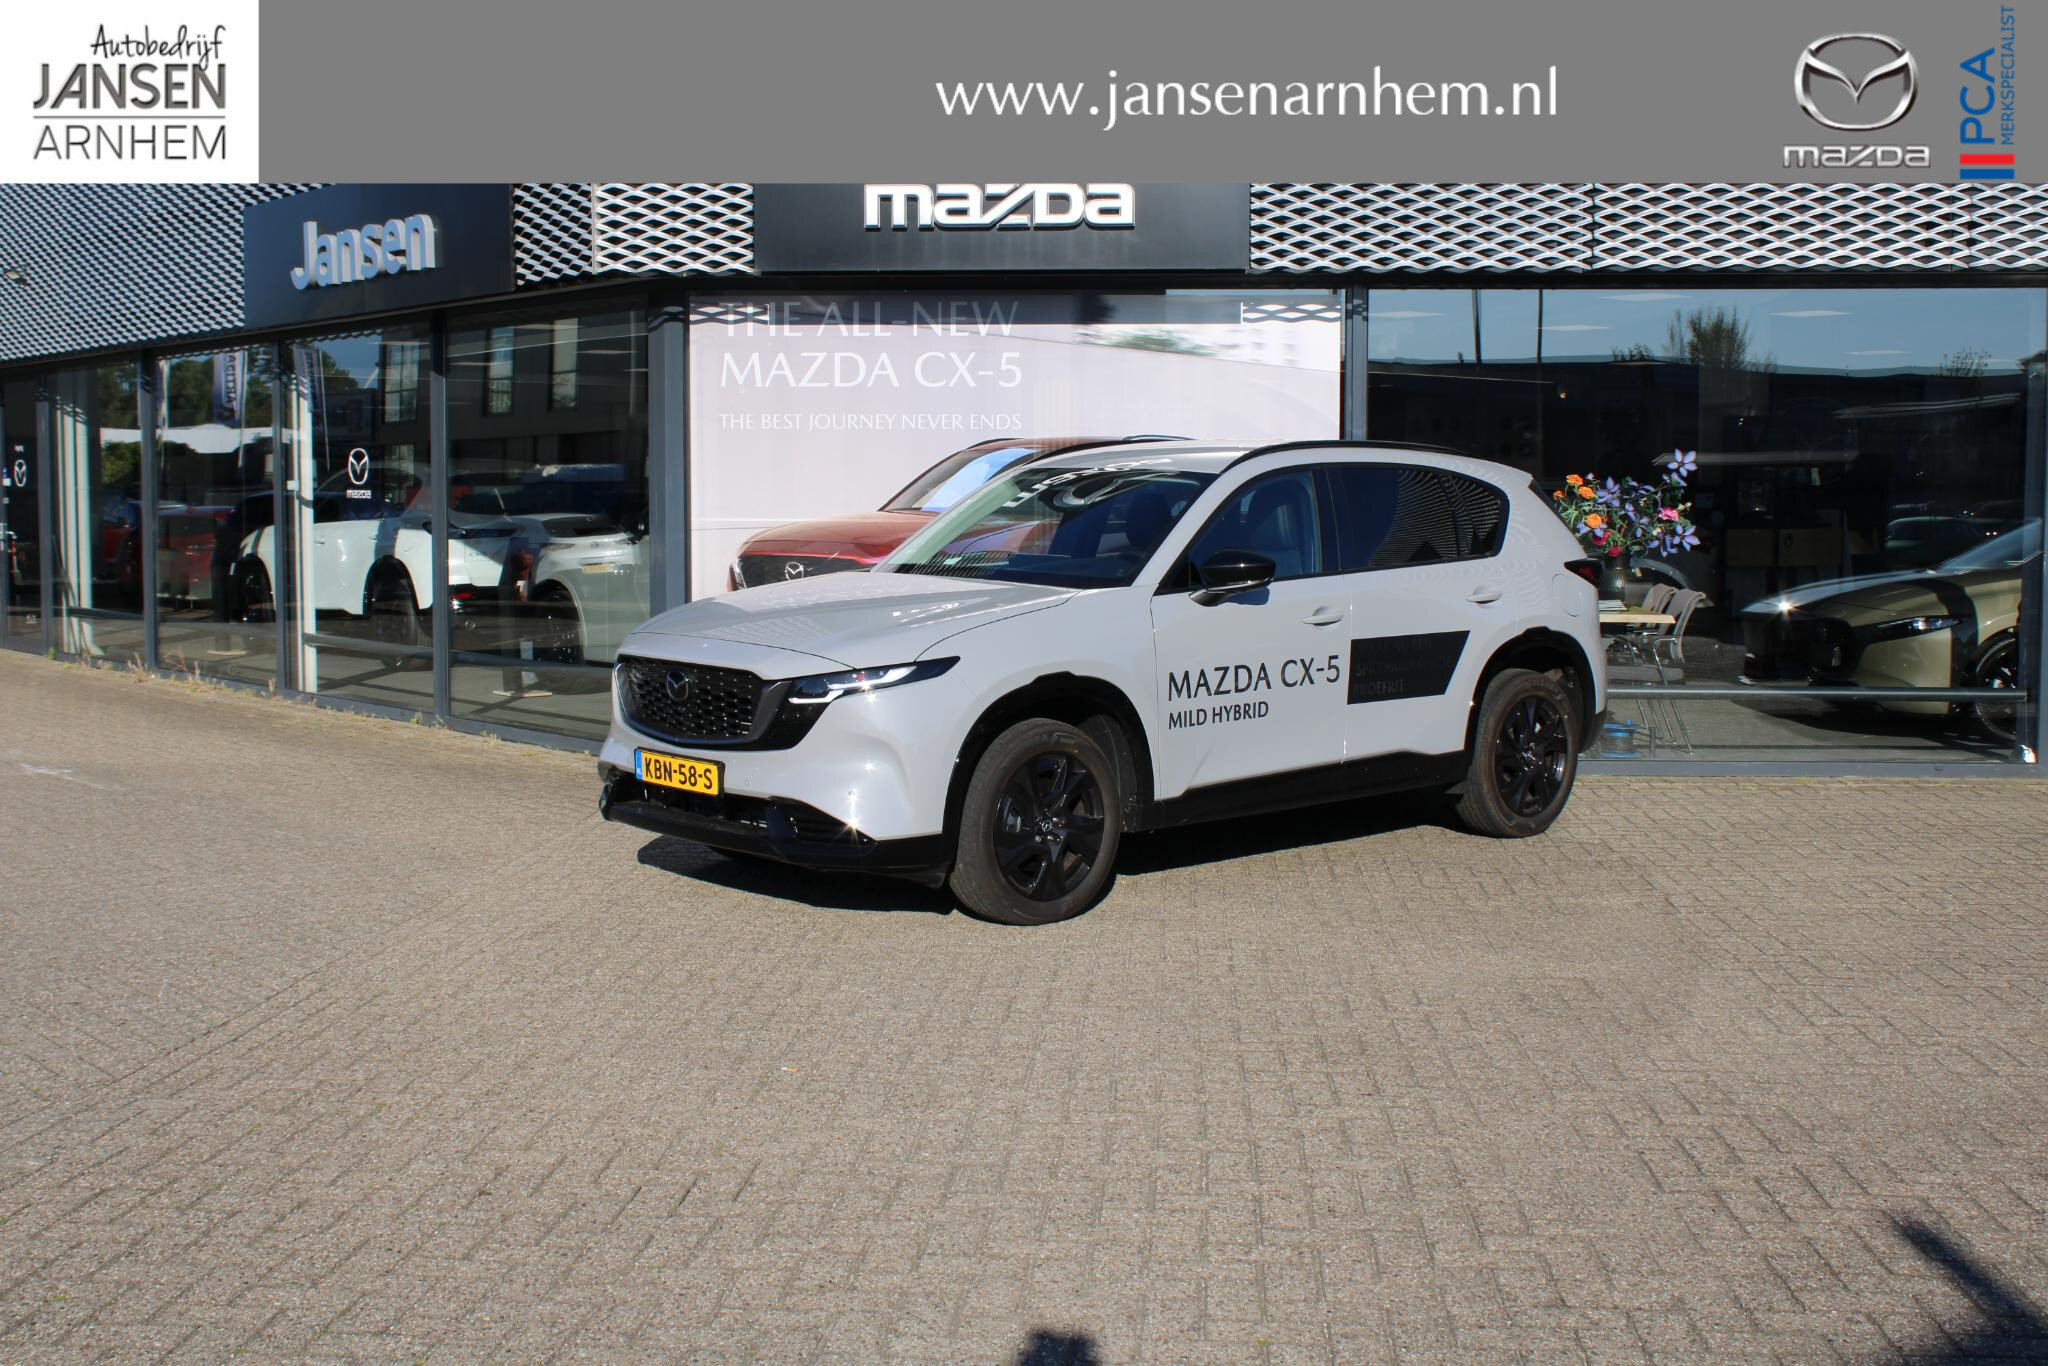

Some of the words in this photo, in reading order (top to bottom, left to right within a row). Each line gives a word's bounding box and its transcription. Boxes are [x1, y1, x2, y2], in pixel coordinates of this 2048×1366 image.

[290, 213, 437, 290] Jansen
[720, 301, 803, 337] THE
[817, 301, 1018, 337] ALL-NEW
[721, 352, 900, 388] MAZDA
[914, 352, 1022, 388] CX-5
[720, 413, 755, 430] THE
[761, 413, 802, 430] BEST
[806, 413, 898, 432] JOURNEY
[901, 413, 965, 430] NEVER
[970, 413, 1022, 430] ENDS
[1168, 663, 1272, 702] MAZDA
[1280, 655, 1341, 687] CX-5
[1168, 708, 1207, 730] MILD
[1212, 701, 1269, 725] HYBRID
[644, 756, 713, 790] KBN-58-S
